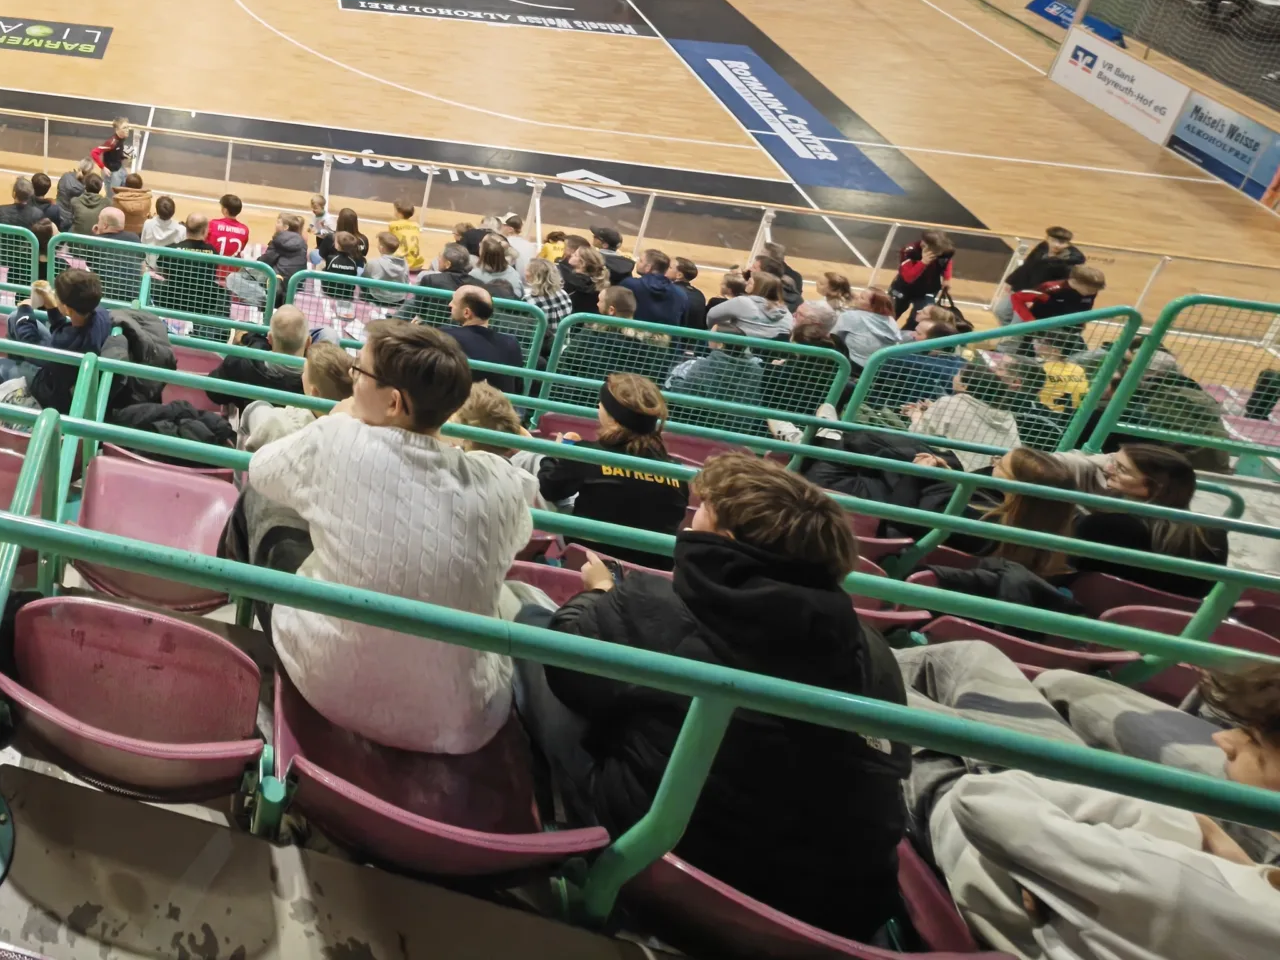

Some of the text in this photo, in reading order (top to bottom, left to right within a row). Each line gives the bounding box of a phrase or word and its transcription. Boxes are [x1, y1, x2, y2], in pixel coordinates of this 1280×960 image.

[358, 0, 511, 22] ALKOHOLFREI
[517, 14, 573, 29] Weisse
[1101, 59, 1137, 84] VR Bank
[722, 59, 839, 161] ROTMAIN-CENTER
[1096, 70, 1154, 108] Bayreuth-Hof
[1153, 104, 1168, 117] eG
[1184, 123, 1253, 165] ALKOHOLFREI
[1189, 104, 1226, 134] Maisel's
[1227, 123, 1261, 152] Weisse
[311, 148, 548, 190] schlaeger
[217, 236, 243, 257] 12
